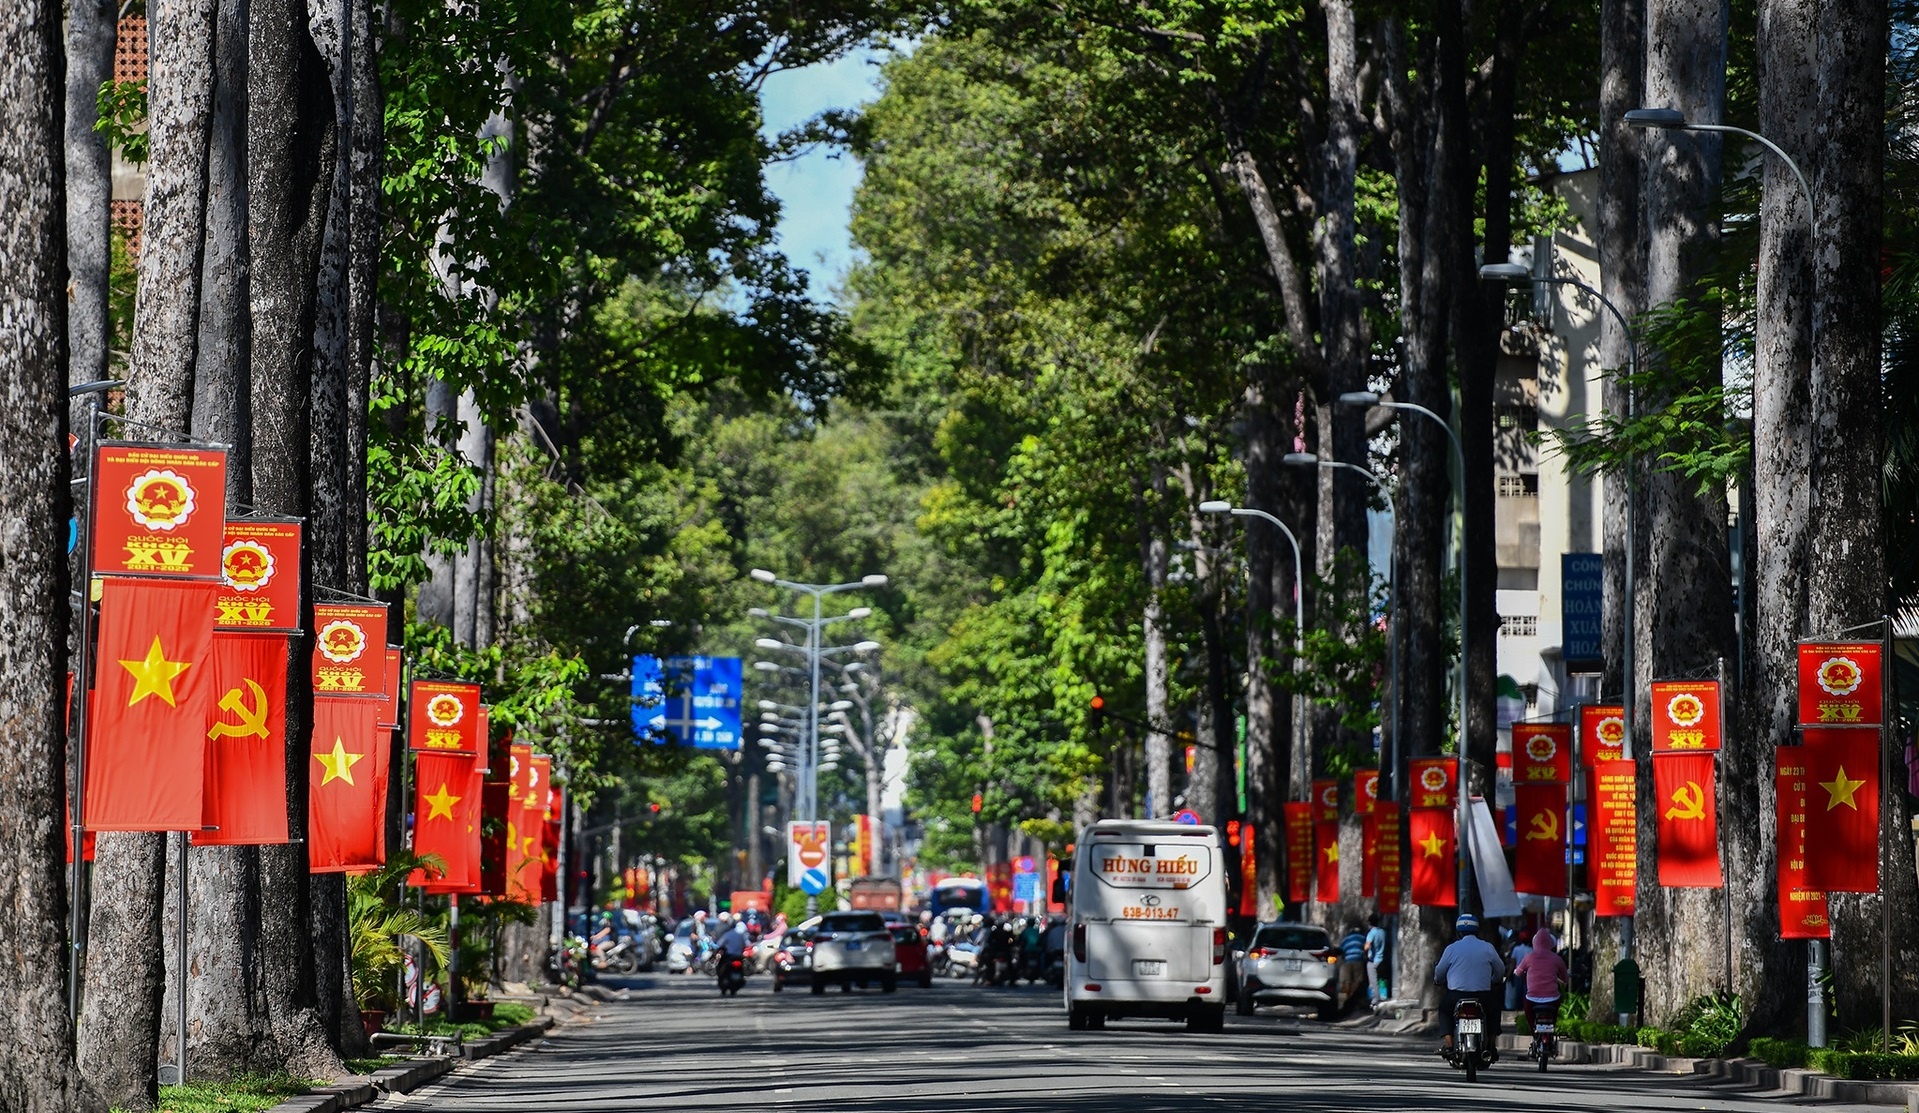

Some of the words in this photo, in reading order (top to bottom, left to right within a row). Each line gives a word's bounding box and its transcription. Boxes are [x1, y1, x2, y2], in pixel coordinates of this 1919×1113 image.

[128, 548, 189, 565] XV
[1572, 558, 1602, 572] CÔN
[219, 607, 271, 620] XV
[1570, 617, 1602, 634] XUÂ
[320, 676, 362, 687] XV
[1820, 708, 1860, 718] XV
[428, 734, 460, 746] XV
[1670, 734, 1703, 746] XV
[1793, 767, 1799, 775] 23
[1103, 855, 1152, 874] HÙNG
[1156, 854, 1198, 874] HIẾU
[1123, 906, 1179, 918] 63B-013.47
